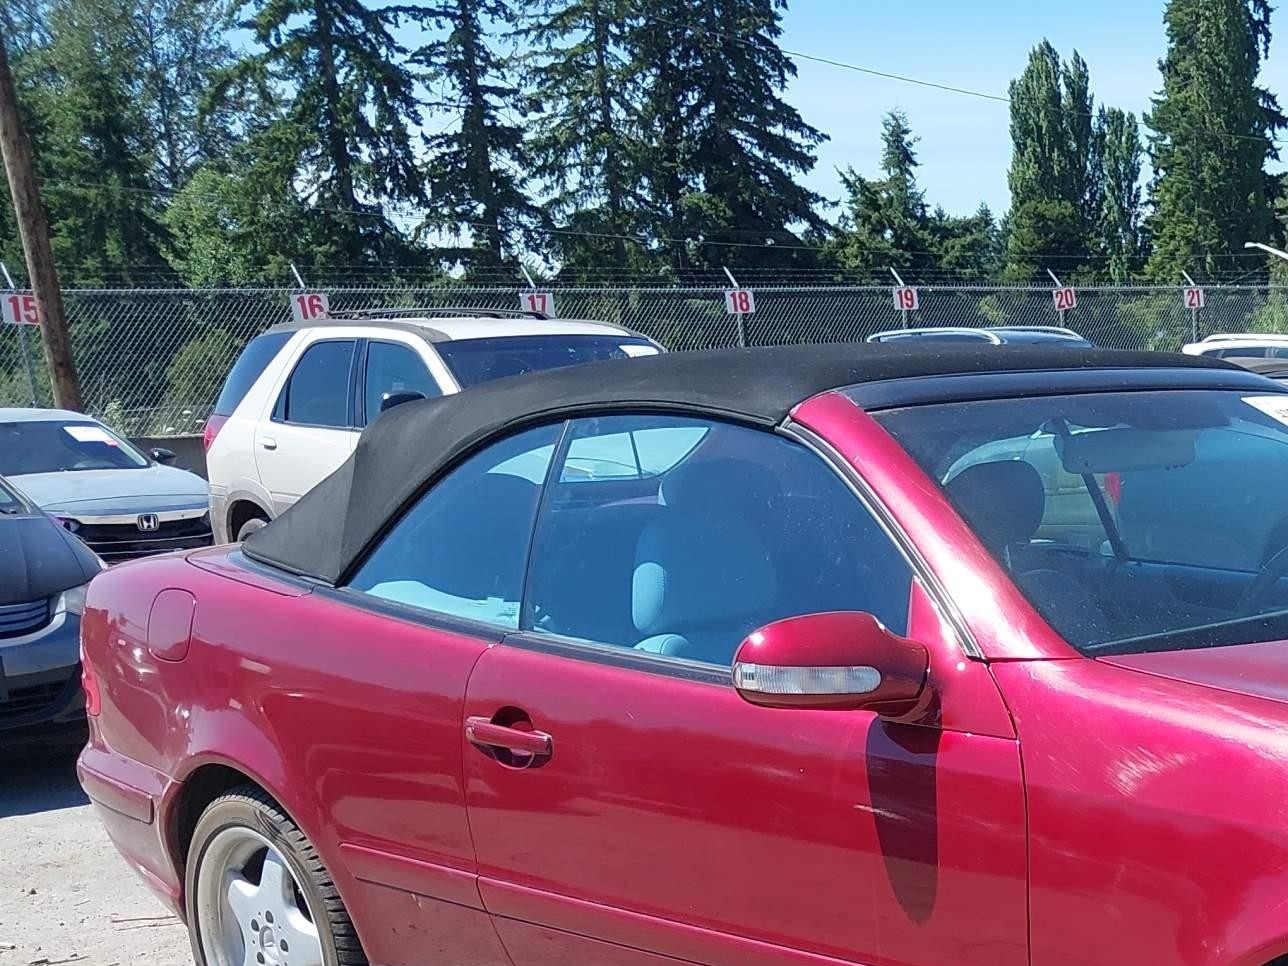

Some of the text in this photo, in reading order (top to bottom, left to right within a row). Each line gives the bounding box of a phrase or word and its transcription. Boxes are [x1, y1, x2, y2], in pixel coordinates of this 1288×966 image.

[297, 295, 324, 320] 16
[528, 294, 546, 313] 17
[730, 291, 750, 312] 18
[897, 289, 914, 309] 19
[1056, 289, 1074, 309] 20
[1187, 290, 1200, 306] 21
[8, 296, 39, 323] 15
